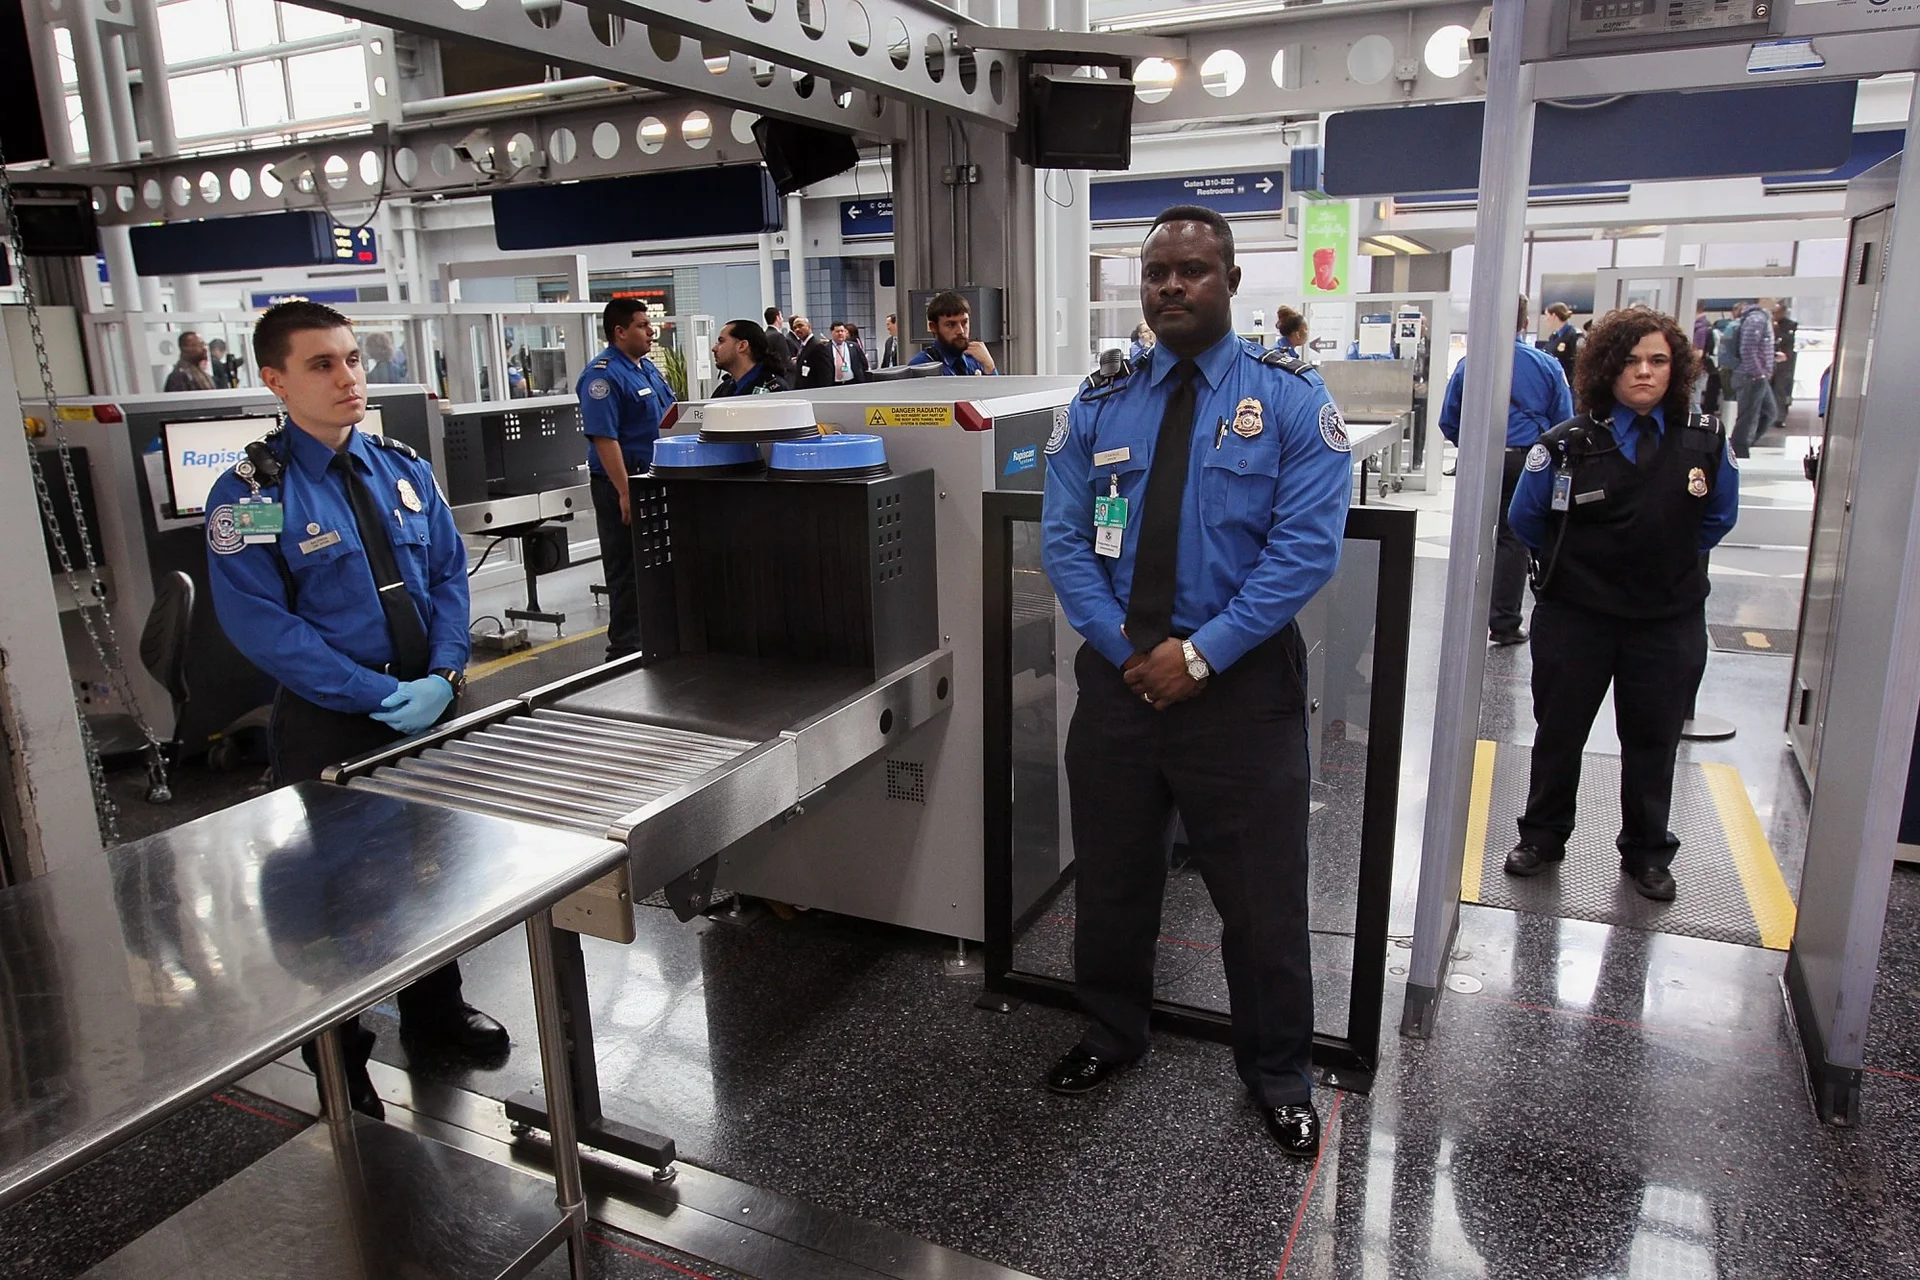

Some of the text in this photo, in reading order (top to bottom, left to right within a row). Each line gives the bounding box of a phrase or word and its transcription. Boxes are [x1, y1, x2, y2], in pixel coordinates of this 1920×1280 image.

[1183, 178, 1235, 188] Gates B10-B22
[1196, 187, 1234, 196] Restrooms
[693, 410, 704, 420] Ra
